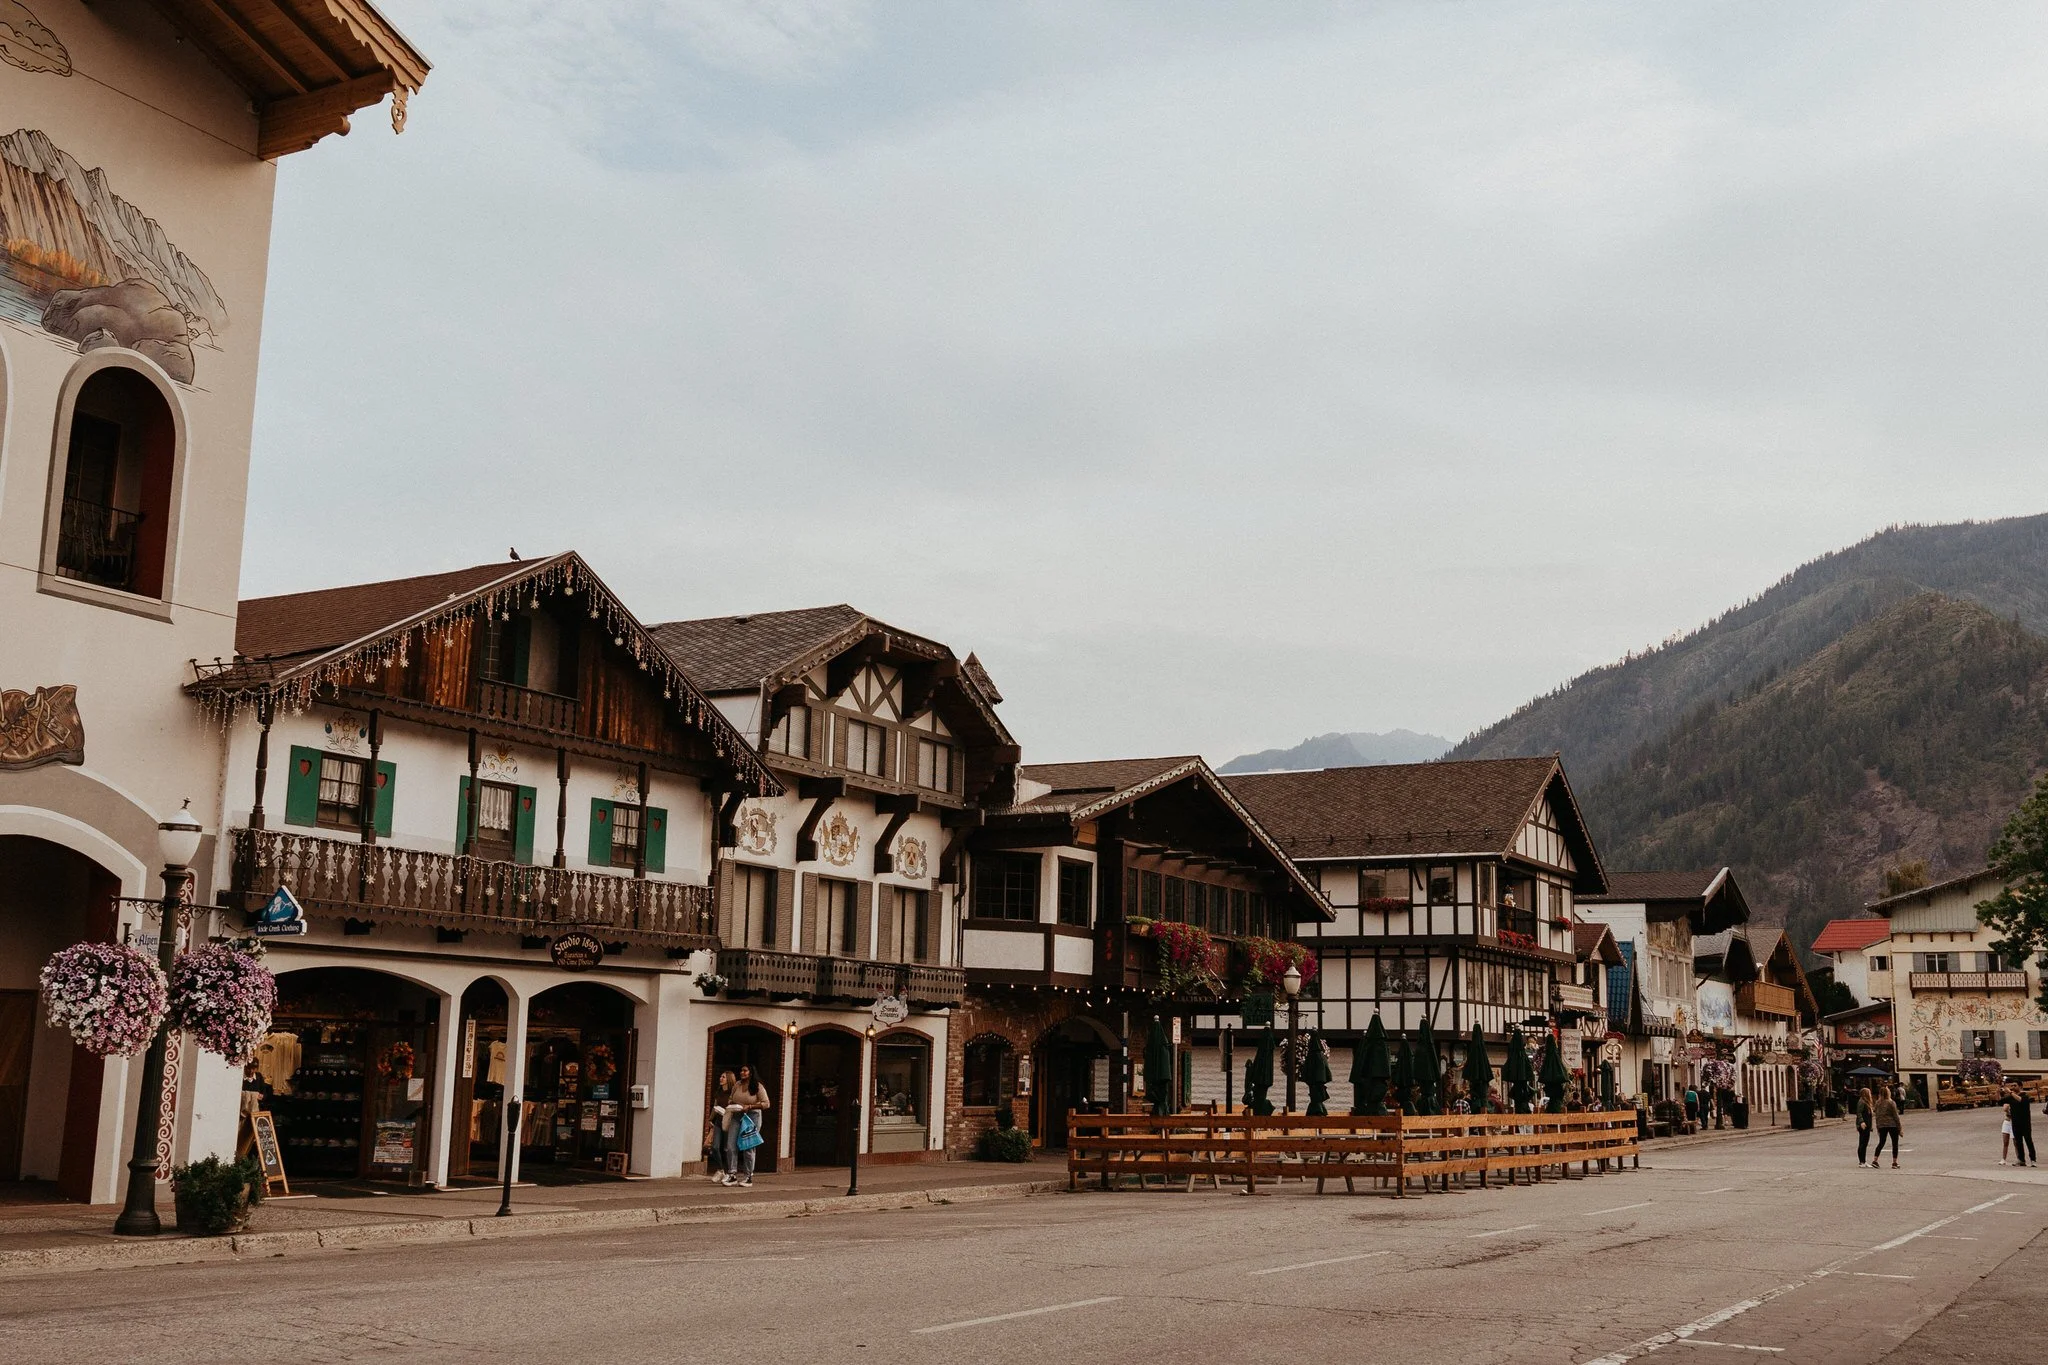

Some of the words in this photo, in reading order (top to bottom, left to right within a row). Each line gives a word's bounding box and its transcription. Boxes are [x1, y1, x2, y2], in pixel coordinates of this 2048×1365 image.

[281, 924, 300, 933] Clothing
[554, 934, 580, 955] Studio
[582, 937, 598, 953] 1890
[464, 1022, 474, 1076] HARVEST
